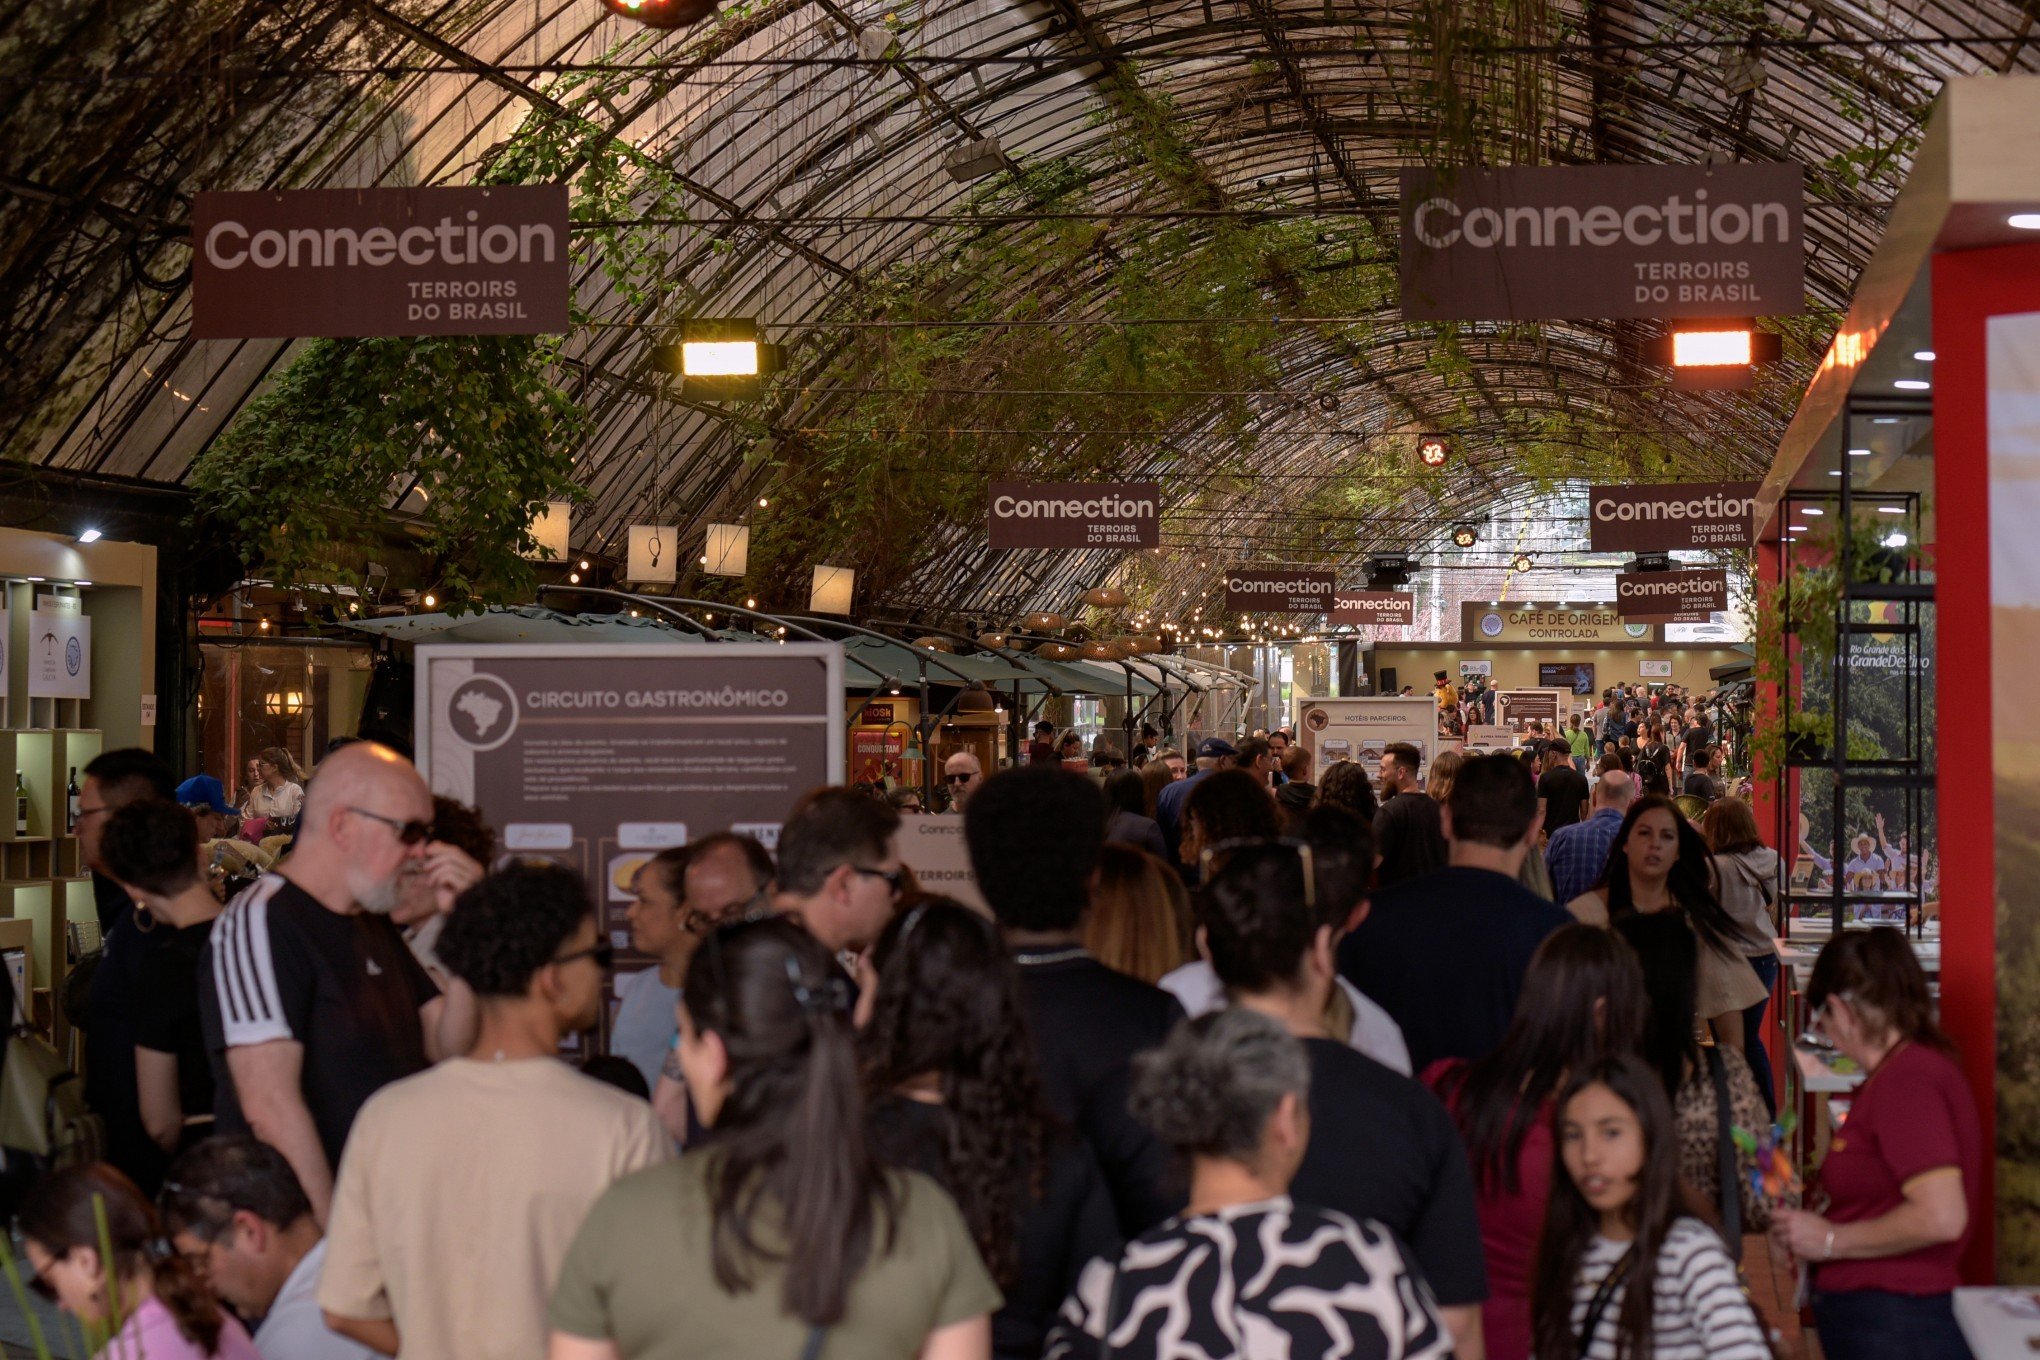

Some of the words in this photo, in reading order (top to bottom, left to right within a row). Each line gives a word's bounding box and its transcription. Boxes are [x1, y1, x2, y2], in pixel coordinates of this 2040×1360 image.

[1413, 188, 1790, 249] Connection
[205, 210, 555, 270] Connection
[1634, 261, 1750, 281] TERROIRS
[408, 280, 517, 299] TERROIRS
[1635, 285, 1670, 303] DO
[1678, 284, 1761, 302] BRASIL
[408, 304, 441, 321] DO
[449, 303, 528, 320] BRASIL
[994, 493, 1154, 518] Connection
[1087, 524, 1137, 533] TERROIRS
[1691, 524, 1742, 534] TERROIRS
[1087, 535, 1103, 543] DO
[1105, 535, 1141, 543] BRASIL
[1691, 535, 1707, 544] DO
[1710, 534, 1747, 543] BRASIL
[1229, 578, 1332, 594] Connection
[1619, 577, 1724, 597] Connection
[1509, 610, 1544, 625] CAFÉ
[1548, 613, 1564, 625] DE
[1569, 613, 1621, 626] ORIGEM
[1528, 628, 1600, 639] CONTROLADA
[1850, 644, 1862, 654] Rio
[1863, 645, 1889, 655] Grande
[1900, 645, 1912, 655] Sl
[526, 690, 620, 709] CIRCUITO
[625, 684, 789, 708] GASTRONÔMICO
[1345, 714, 1368, 722] HOTÉIS
